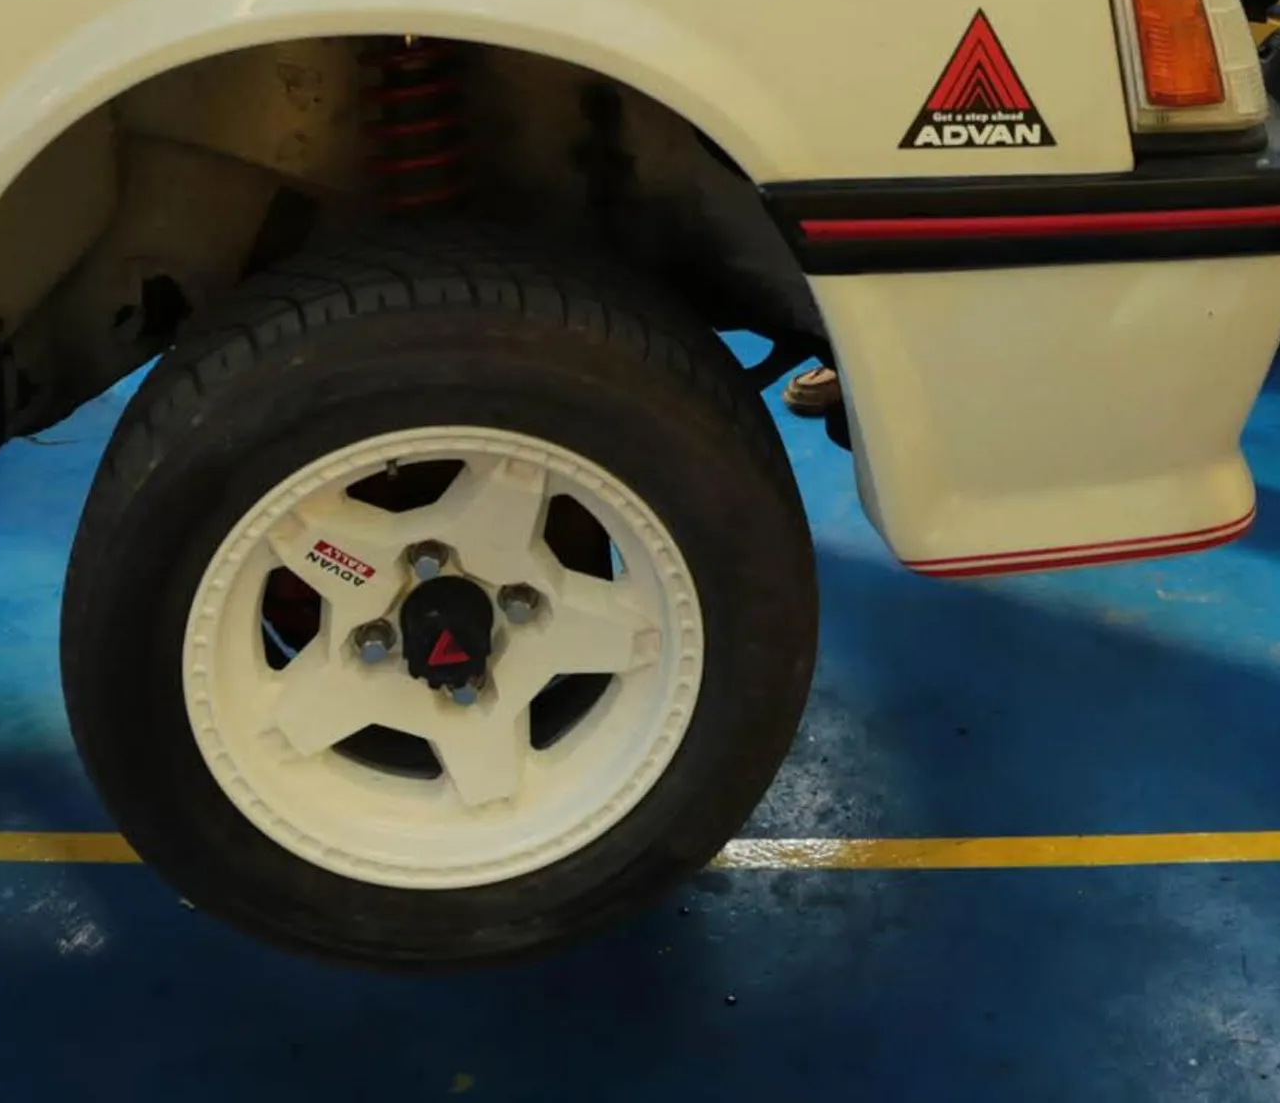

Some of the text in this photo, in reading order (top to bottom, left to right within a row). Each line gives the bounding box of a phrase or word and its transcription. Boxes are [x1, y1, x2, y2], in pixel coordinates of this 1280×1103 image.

[914, 124, 1041, 146] ADVAN
[304, 551, 366, 587] ADVAN
[322, 545, 370, 576] RALLY
